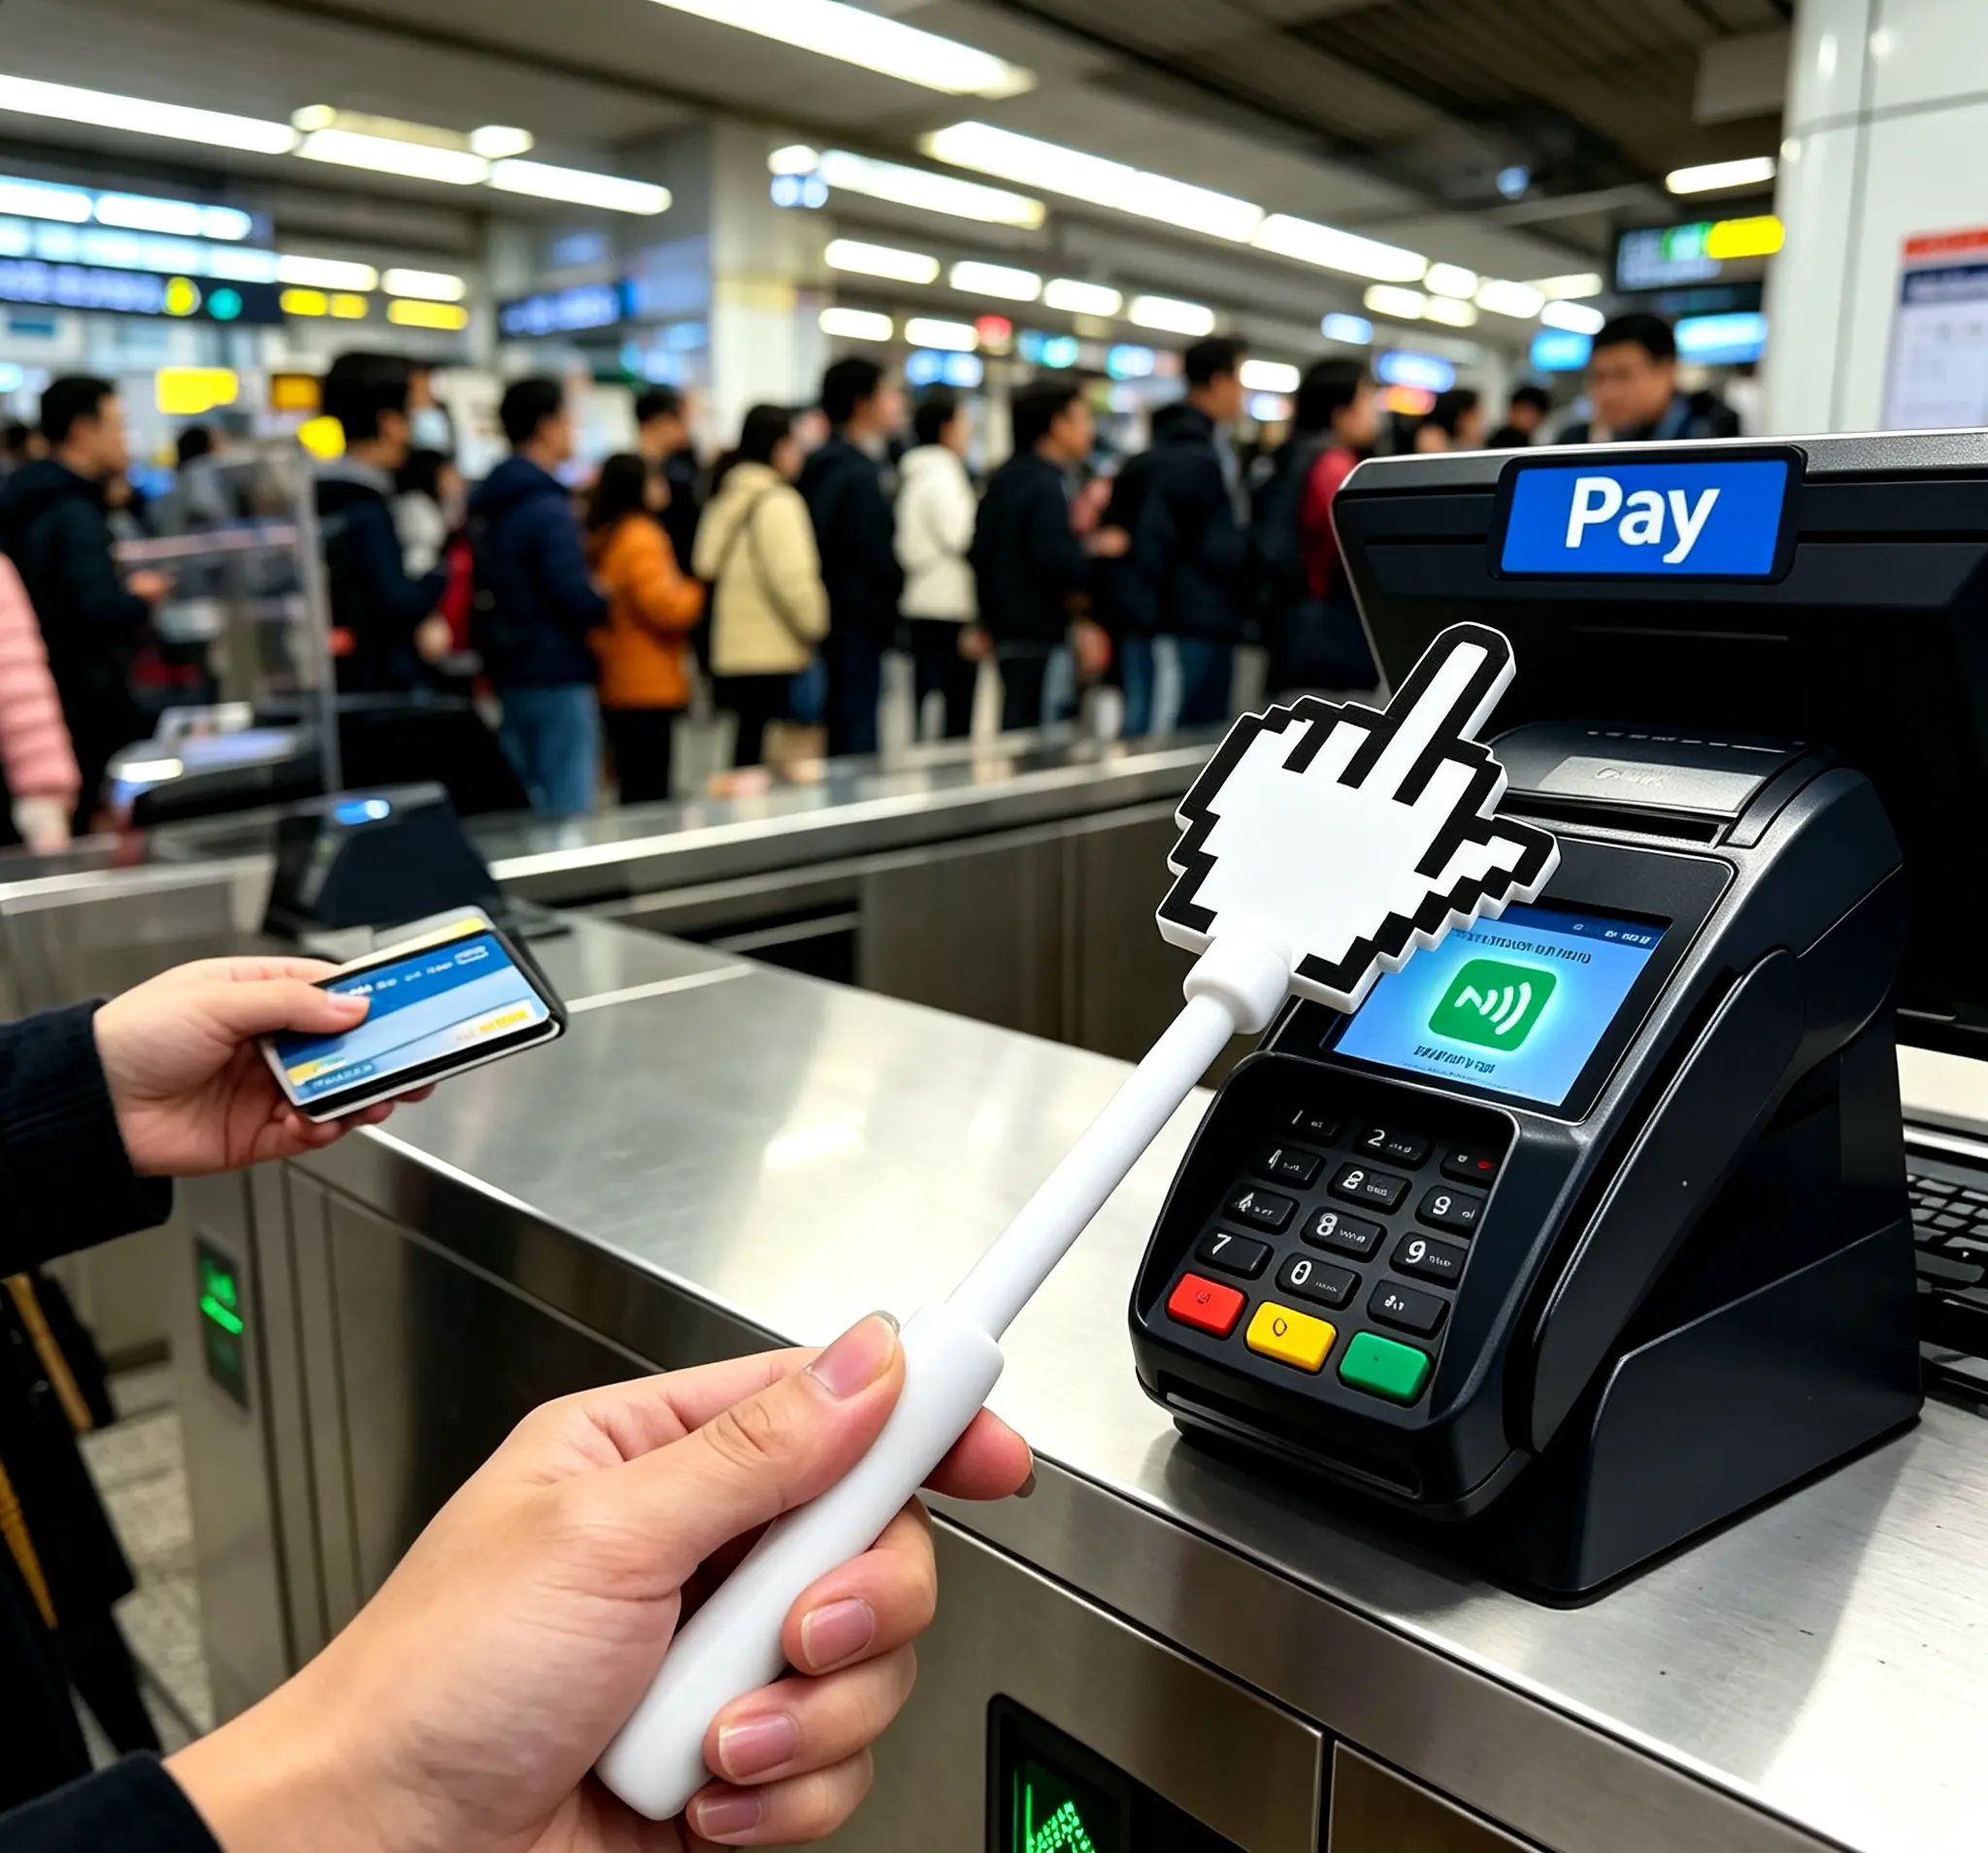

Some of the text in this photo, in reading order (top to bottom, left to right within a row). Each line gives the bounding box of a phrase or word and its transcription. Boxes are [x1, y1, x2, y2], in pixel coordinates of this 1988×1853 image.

[1565, 476, 1721, 564] Pay
[1367, 1129, 1386, 1146] 2
[1315, 1212, 1338, 1237] 8
[1211, 1234, 1232, 1255] 7
[1406, 1241, 1426, 1264] 9
